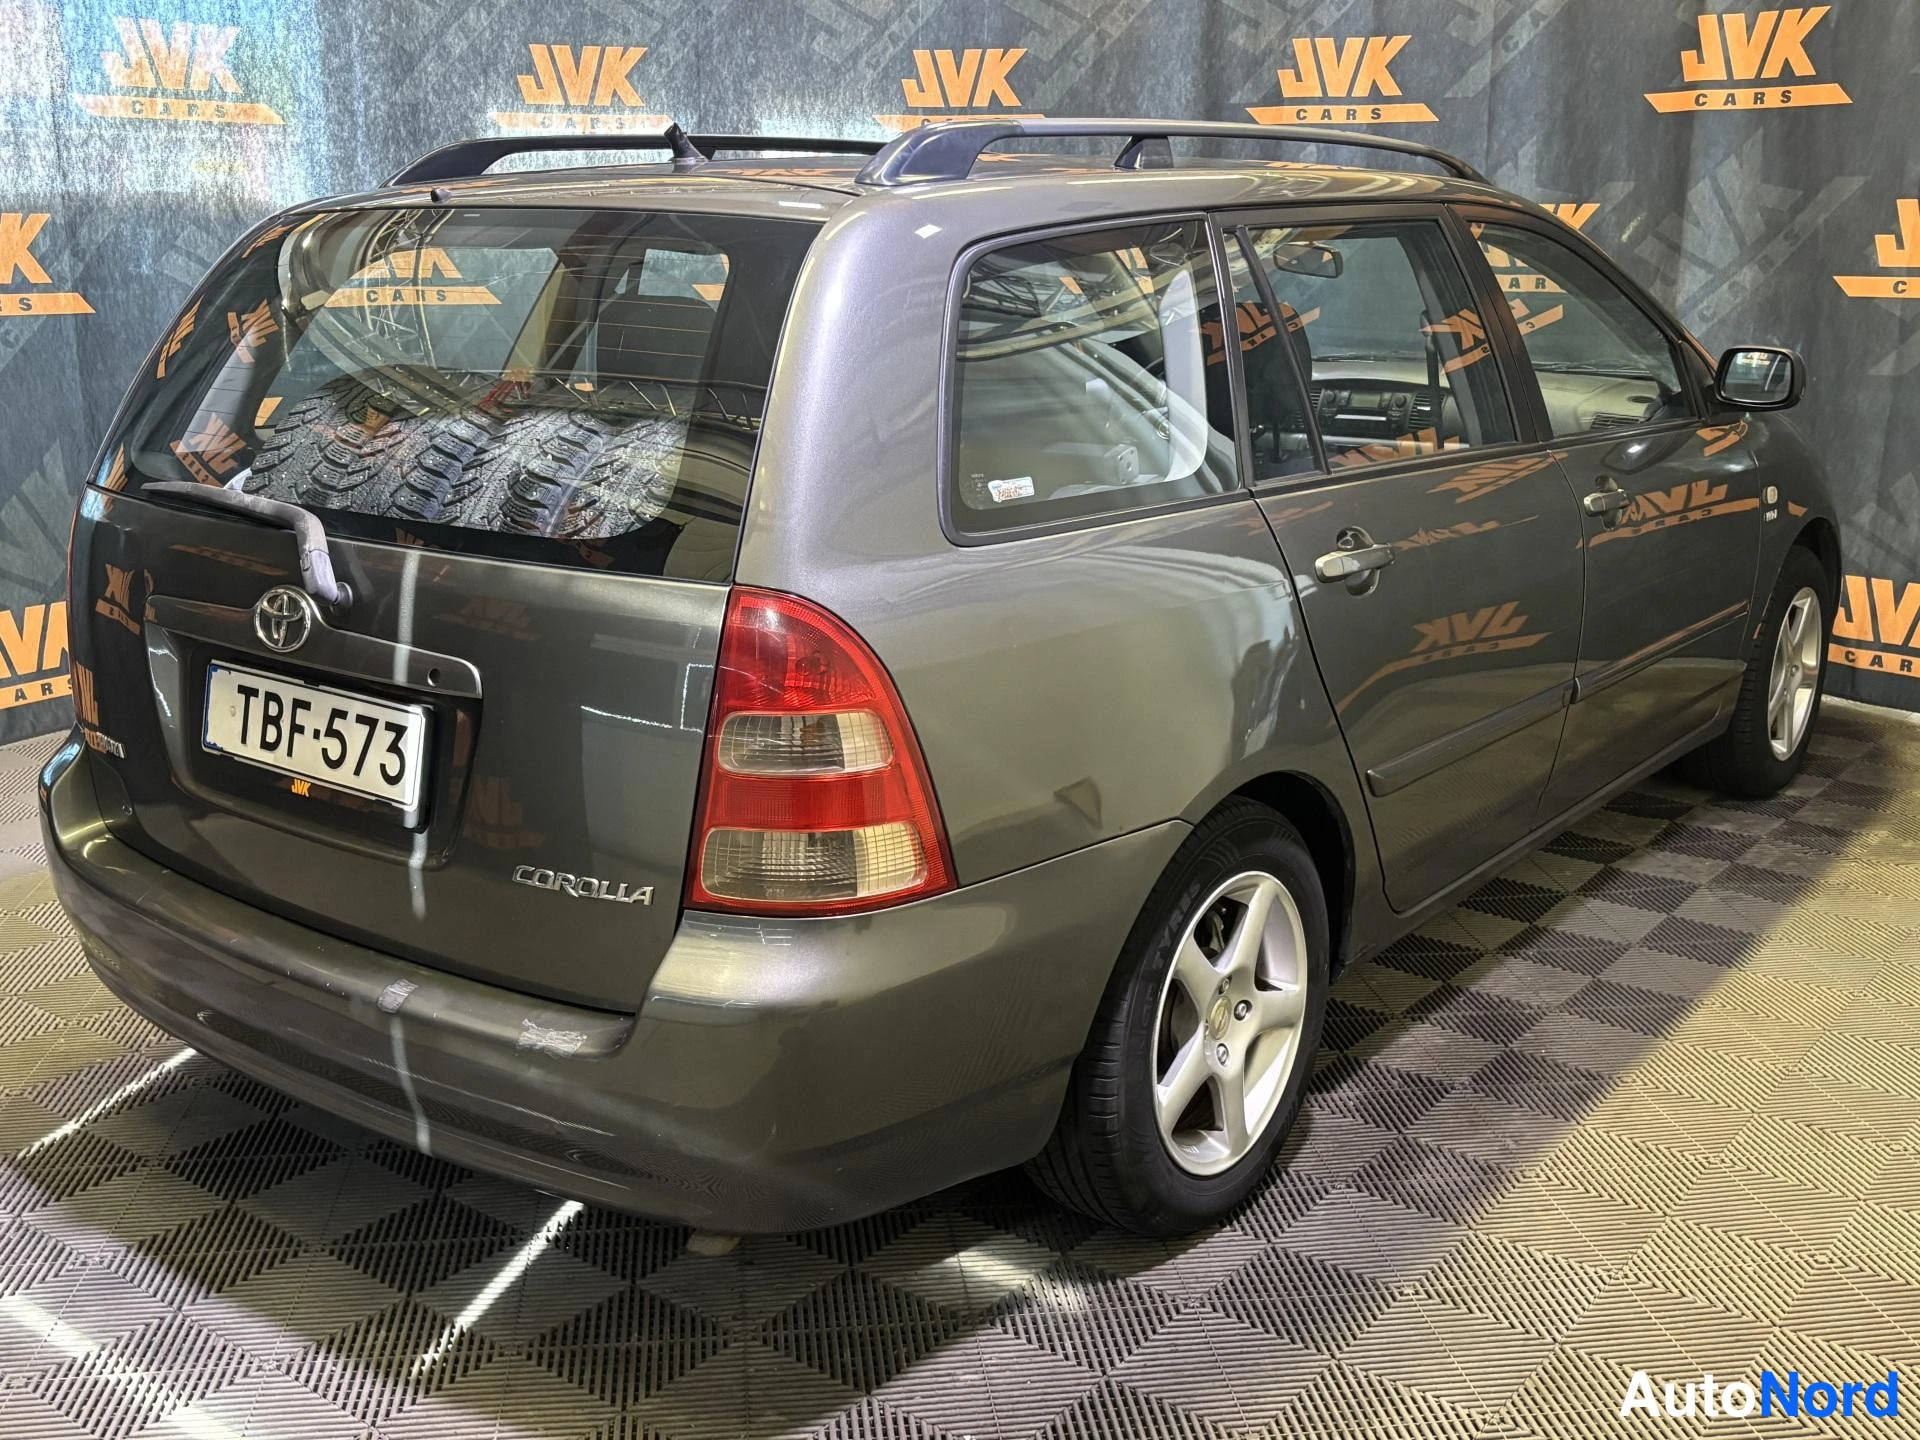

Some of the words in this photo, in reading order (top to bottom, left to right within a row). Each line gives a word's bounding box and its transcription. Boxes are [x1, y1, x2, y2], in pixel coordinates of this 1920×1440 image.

[100, 16, 243, 94] JVK
[1680, 6, 1832, 82] JVK
[517, 43, 648, 107] JVK
[901, 48, 1028, 108] JVK
[1277, 35, 1413, 98] JVK
[131, 100, 226, 119] CARS
[1296, 107, 1382, 121] CARS
[1694, 90, 1793, 107] CARS
[366, 289, 447, 302] CARS
[1508, 277, 1547, 289] AR
[1832, 574, 1920, 649] JV
[1845, 651, 1913, 673] CAR
[237, 684, 408, 786] TBF-573
[291, 778, 312, 798] JVK
[512, 865, 654, 906] COROLLA
